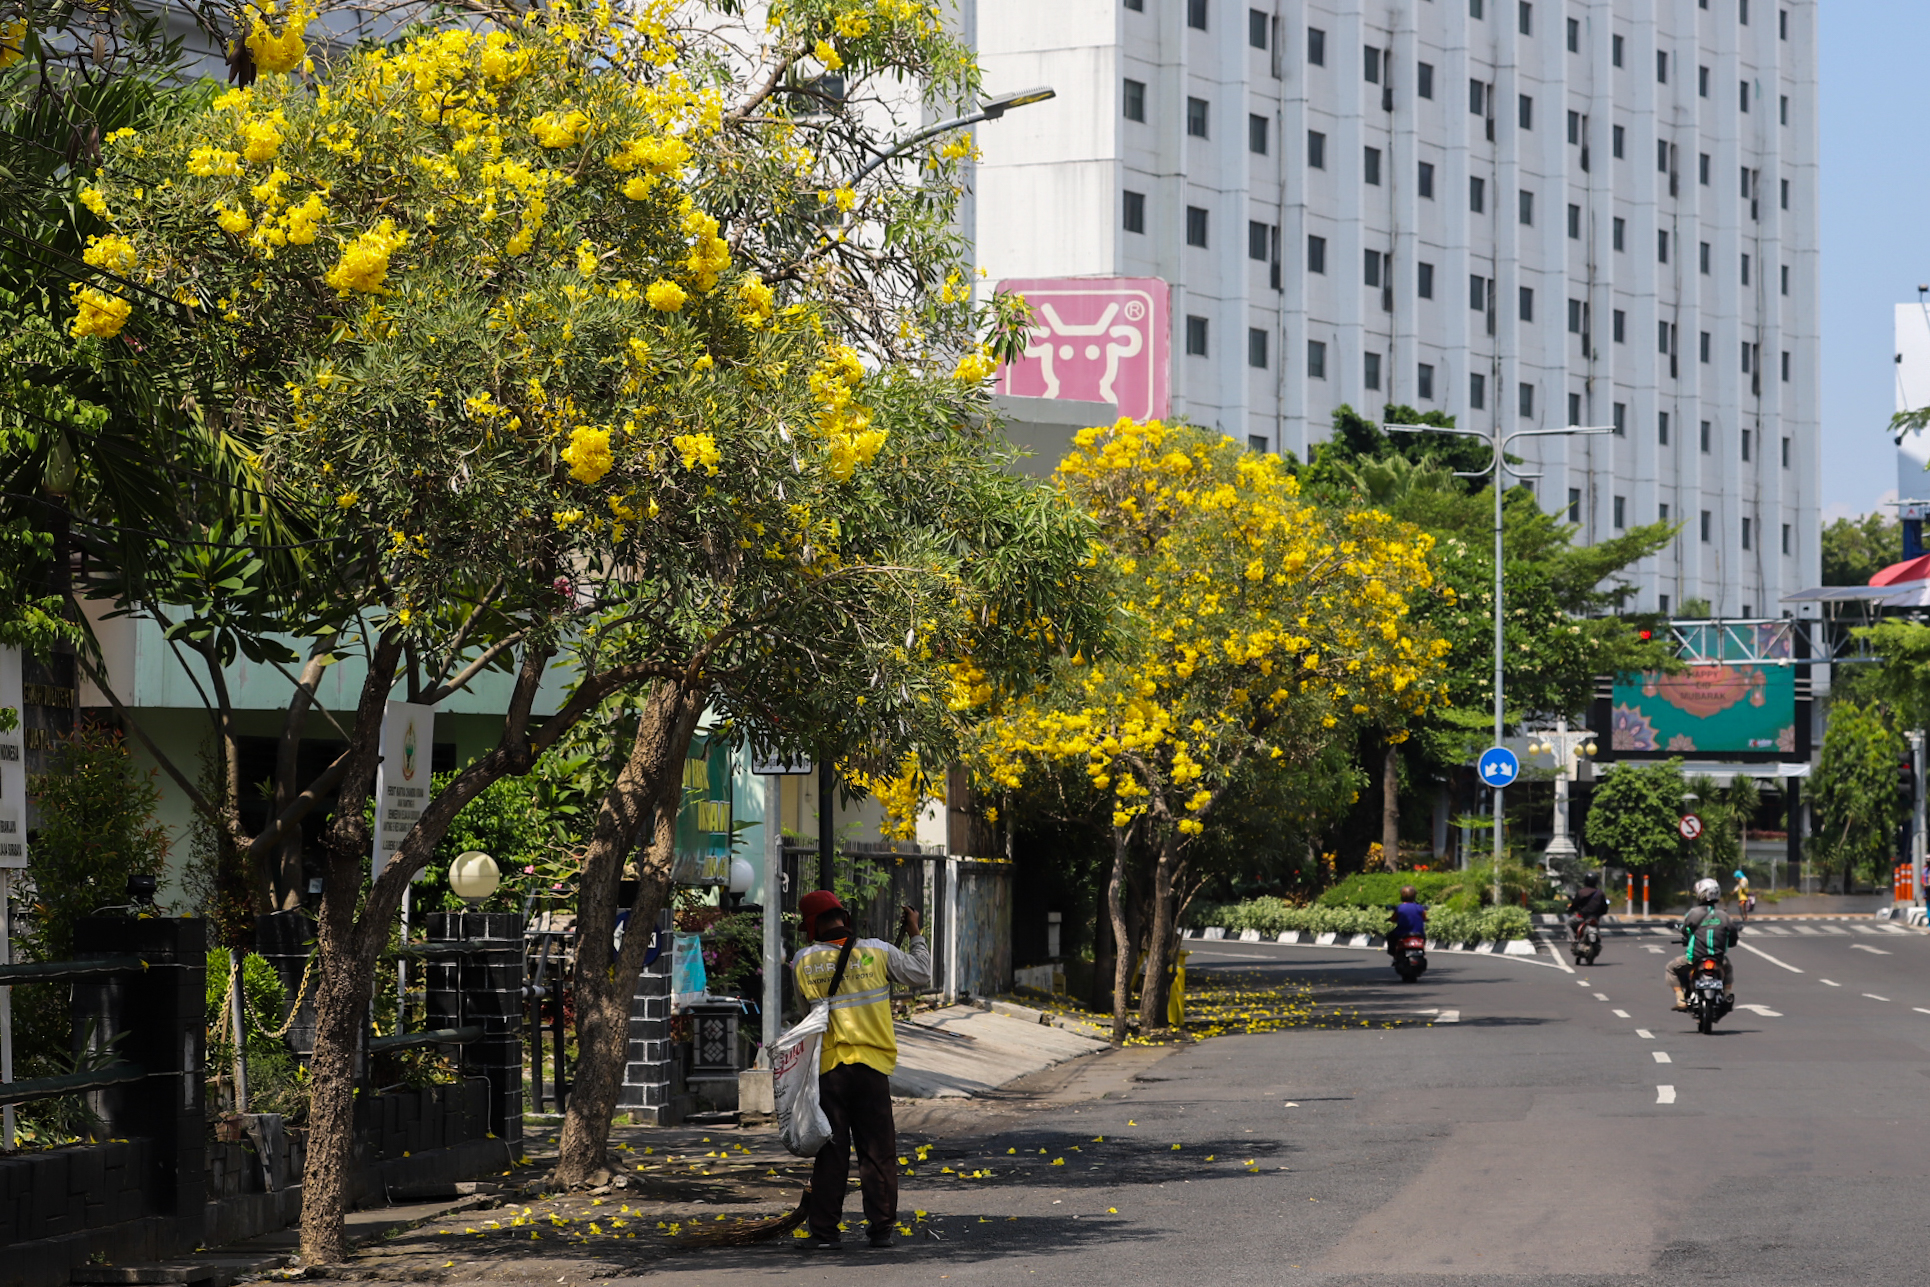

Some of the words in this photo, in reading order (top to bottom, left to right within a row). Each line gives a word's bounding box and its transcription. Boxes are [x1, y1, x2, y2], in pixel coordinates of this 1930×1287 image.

[1696, 682, 1711, 690] EID
[1680, 692, 1726, 700] MUBARAK
[0, 743, 19, 761] NDONESIA
[804, 960, 861, 976] DKRH
[856, 972, 874, 980] 2019
